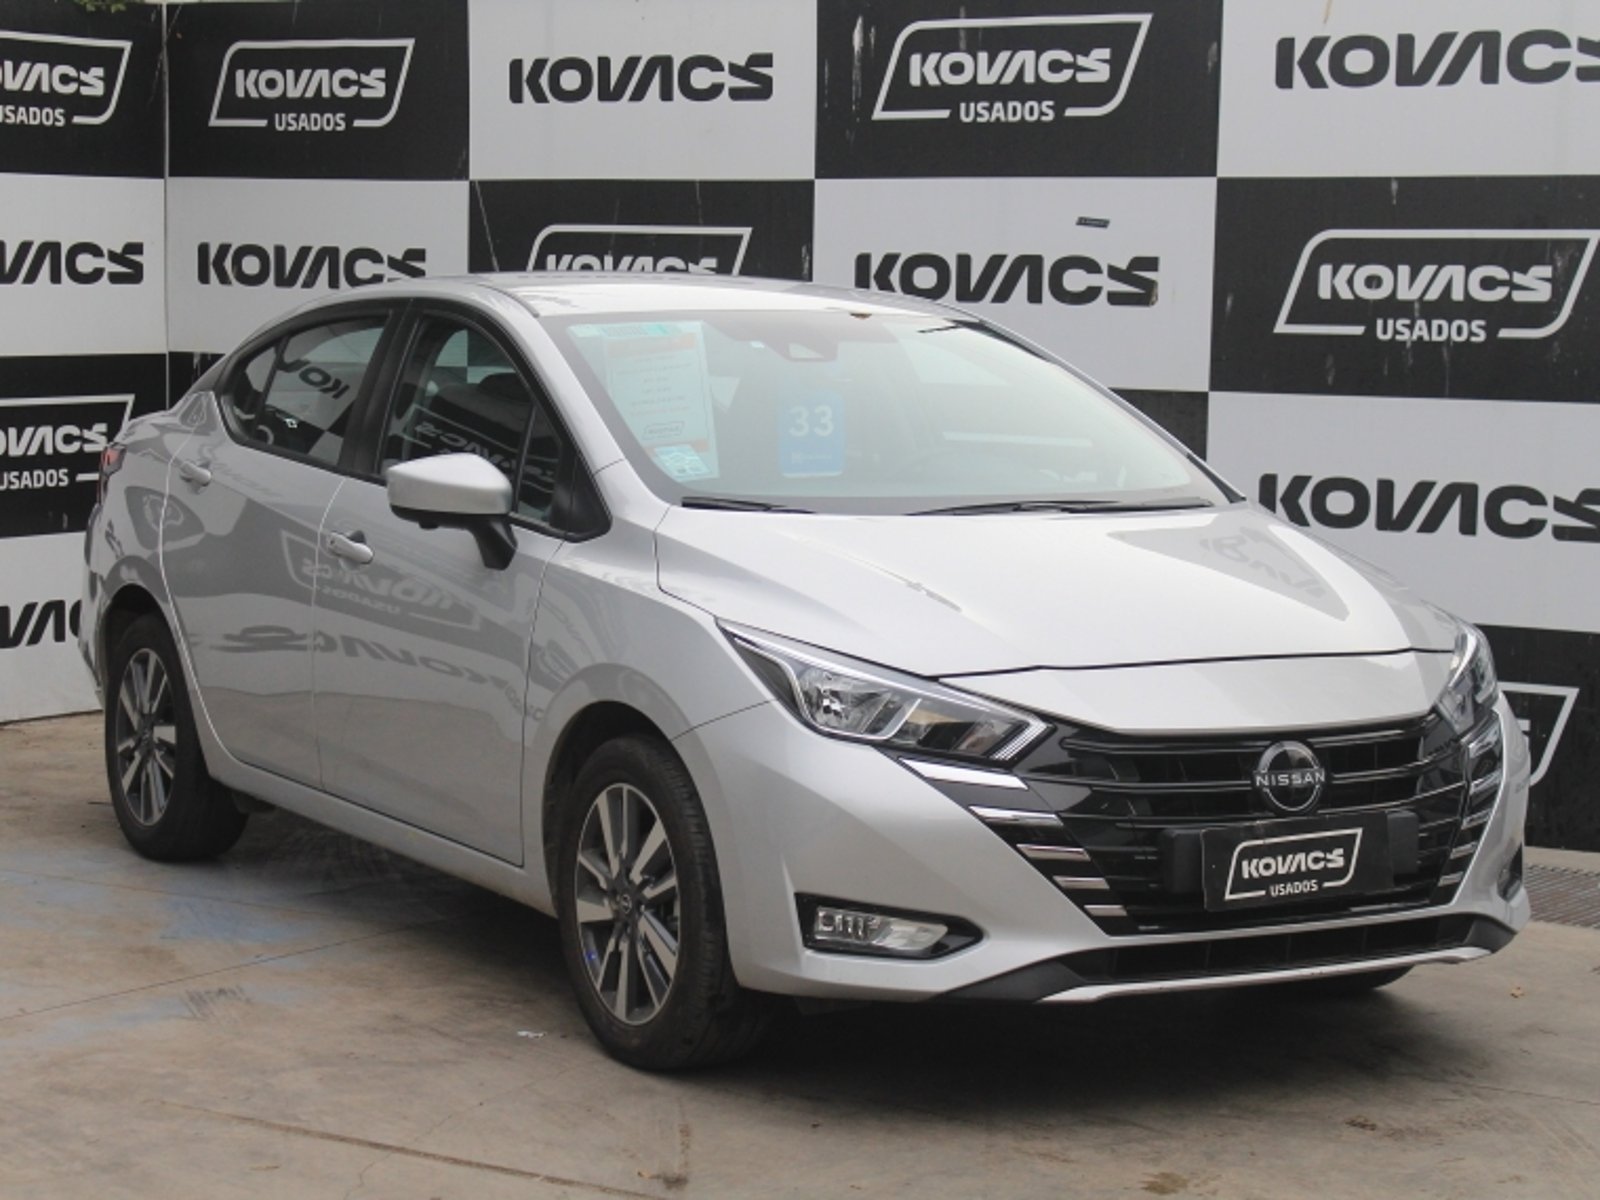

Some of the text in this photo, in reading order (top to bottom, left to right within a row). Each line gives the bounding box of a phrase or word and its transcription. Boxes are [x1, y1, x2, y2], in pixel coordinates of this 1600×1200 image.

[0, 60, 104, 97] VACS
[509, 52, 773, 103] KOVACS
[910, 48, 1111, 86] KOVACS
[235, 69, 386, 98] KOVACS
[0, 104, 65, 127] SADOS
[275, 113, 346, 131] USADOS
[959, 101, 1055, 122] USADOS
[198, 242, 426, 289] KOVACS
[855, 252, 1160, 307] KOVACS
[1318, 264, 1552, 302] KOVACS
[1376, 318, 1487, 342] USADOS
[789, 405, 834, 437] 33
[0, 423, 107, 457] VACS
[1256, 769, 1326, 787] NISSAN
[1242, 848, 1345, 879] KOVACS
[1270, 880, 1319, 898] USADOS
